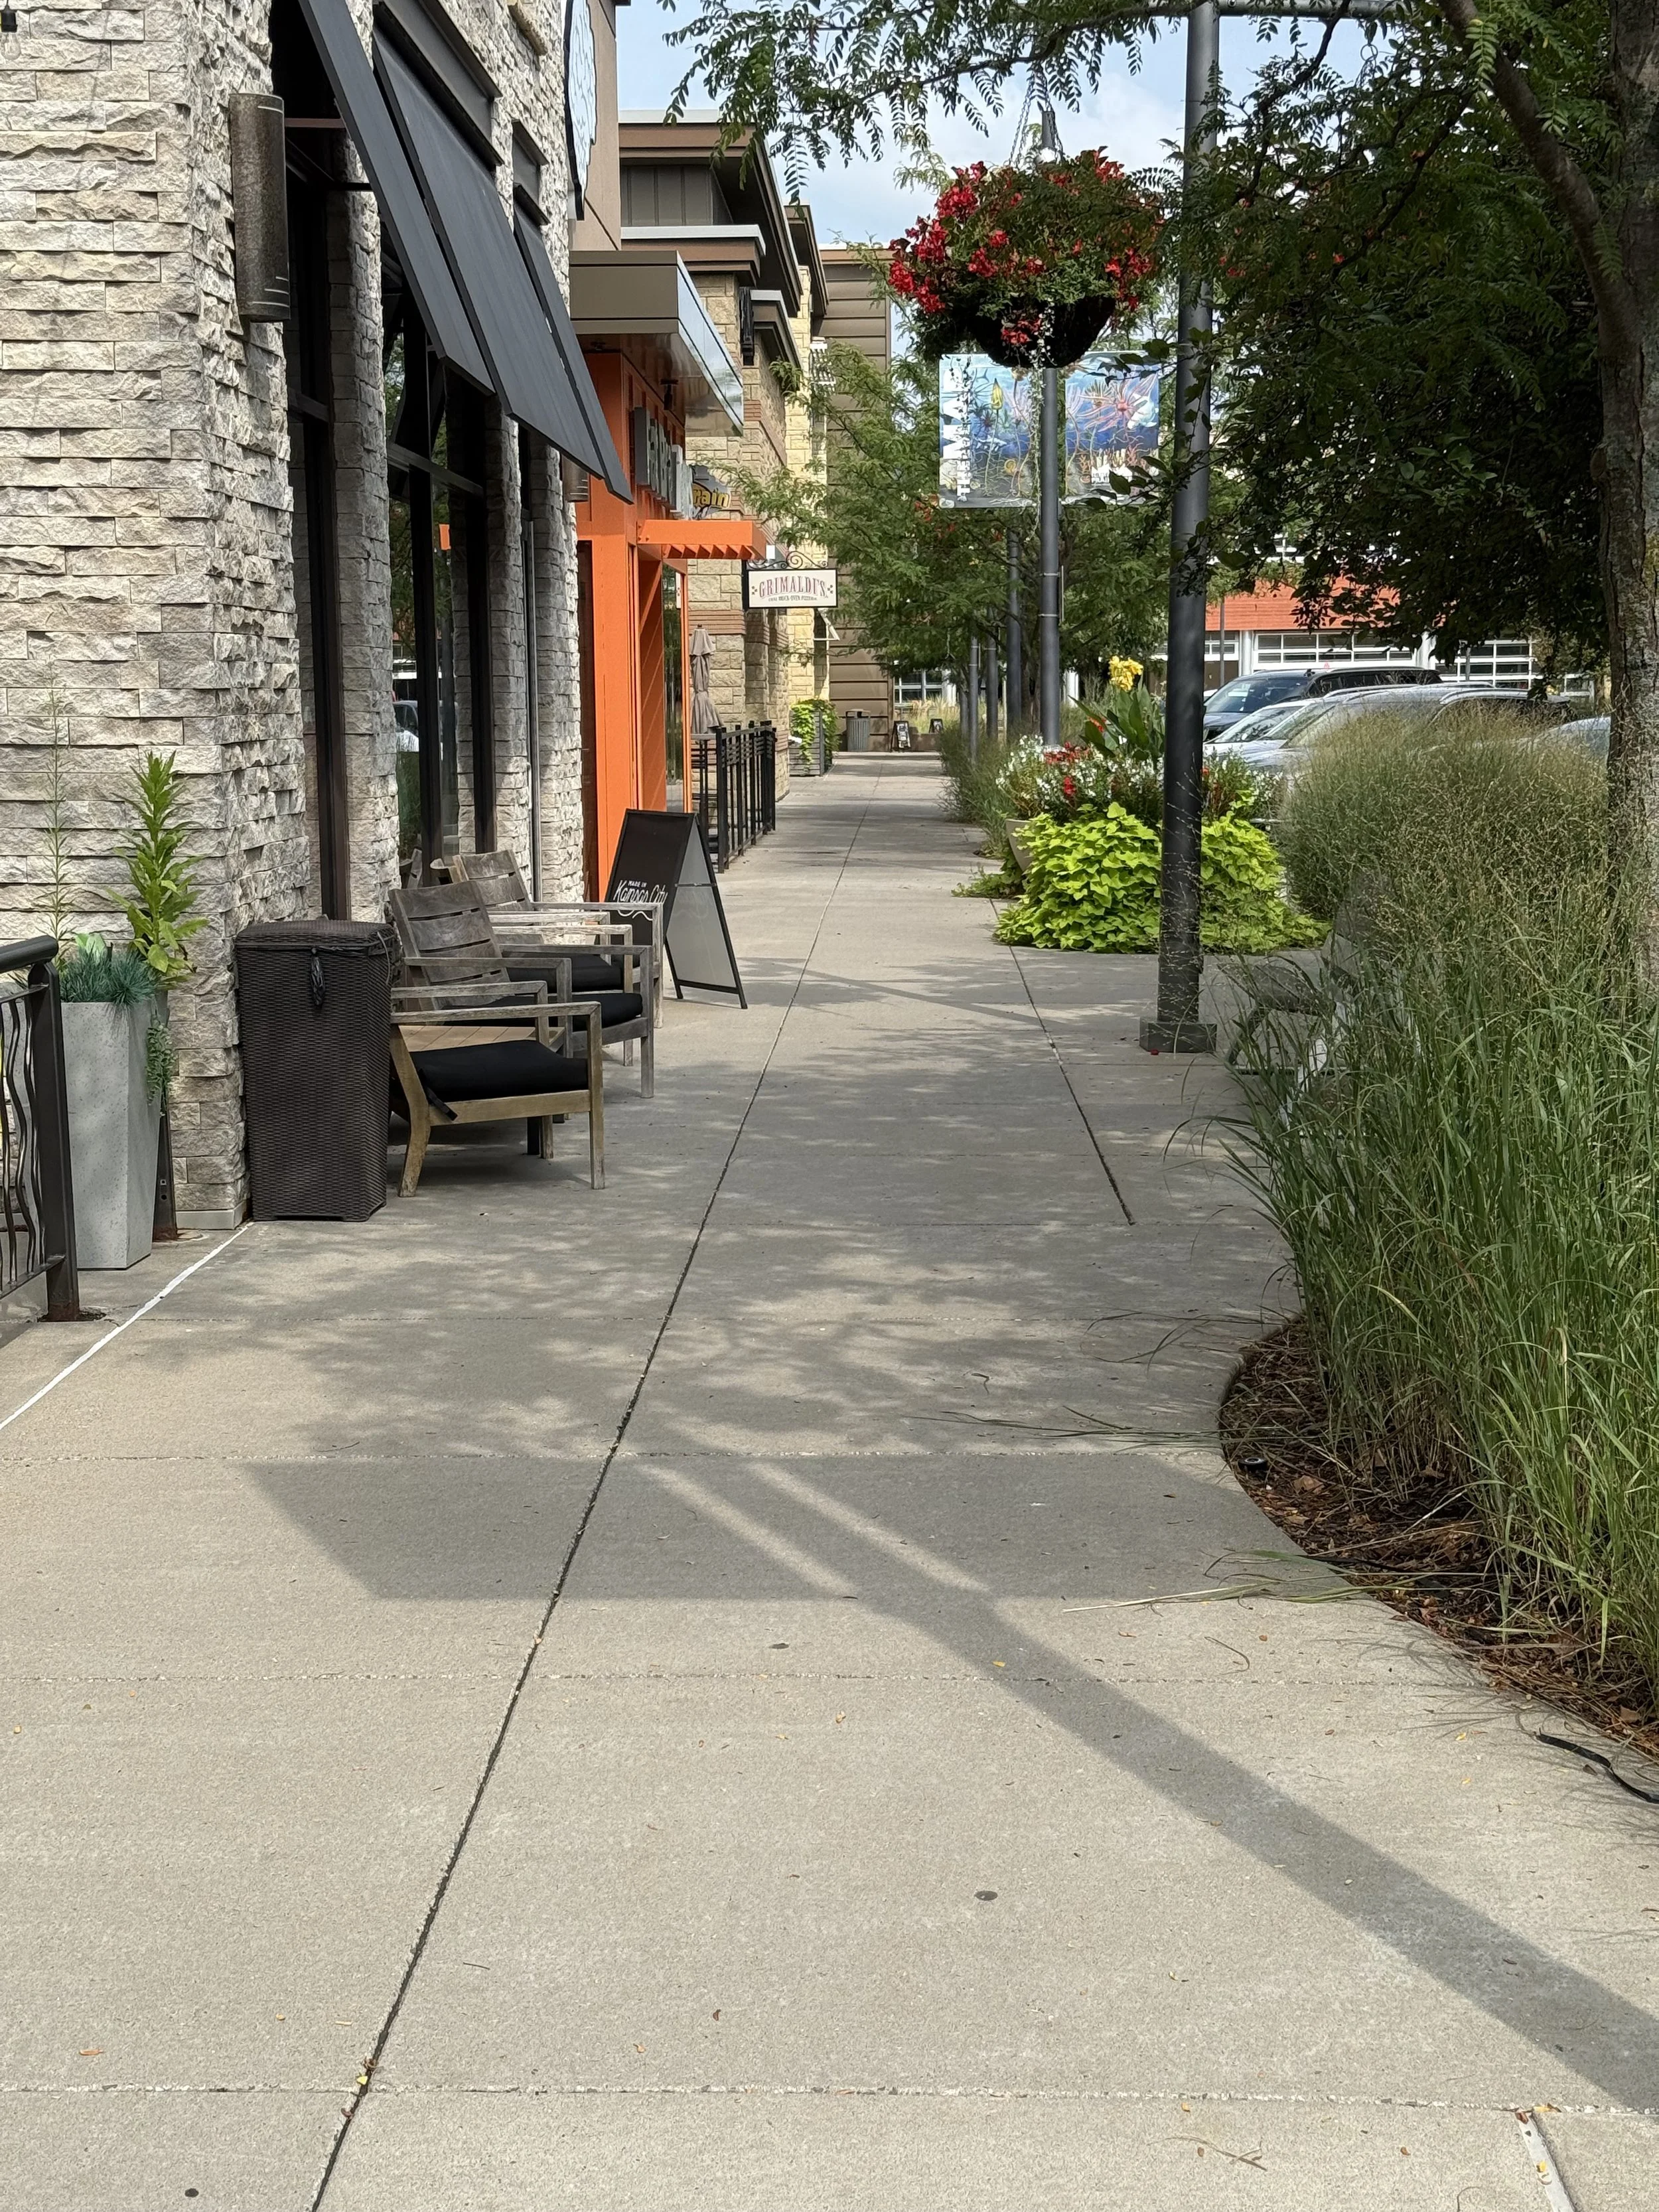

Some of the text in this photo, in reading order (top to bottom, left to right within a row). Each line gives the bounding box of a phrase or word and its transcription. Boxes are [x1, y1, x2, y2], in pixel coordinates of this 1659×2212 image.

[693, 488, 729, 508] rain
[759, 575, 826, 598] GRIMALDI'S
[613, 879, 668, 903] Kansas City
